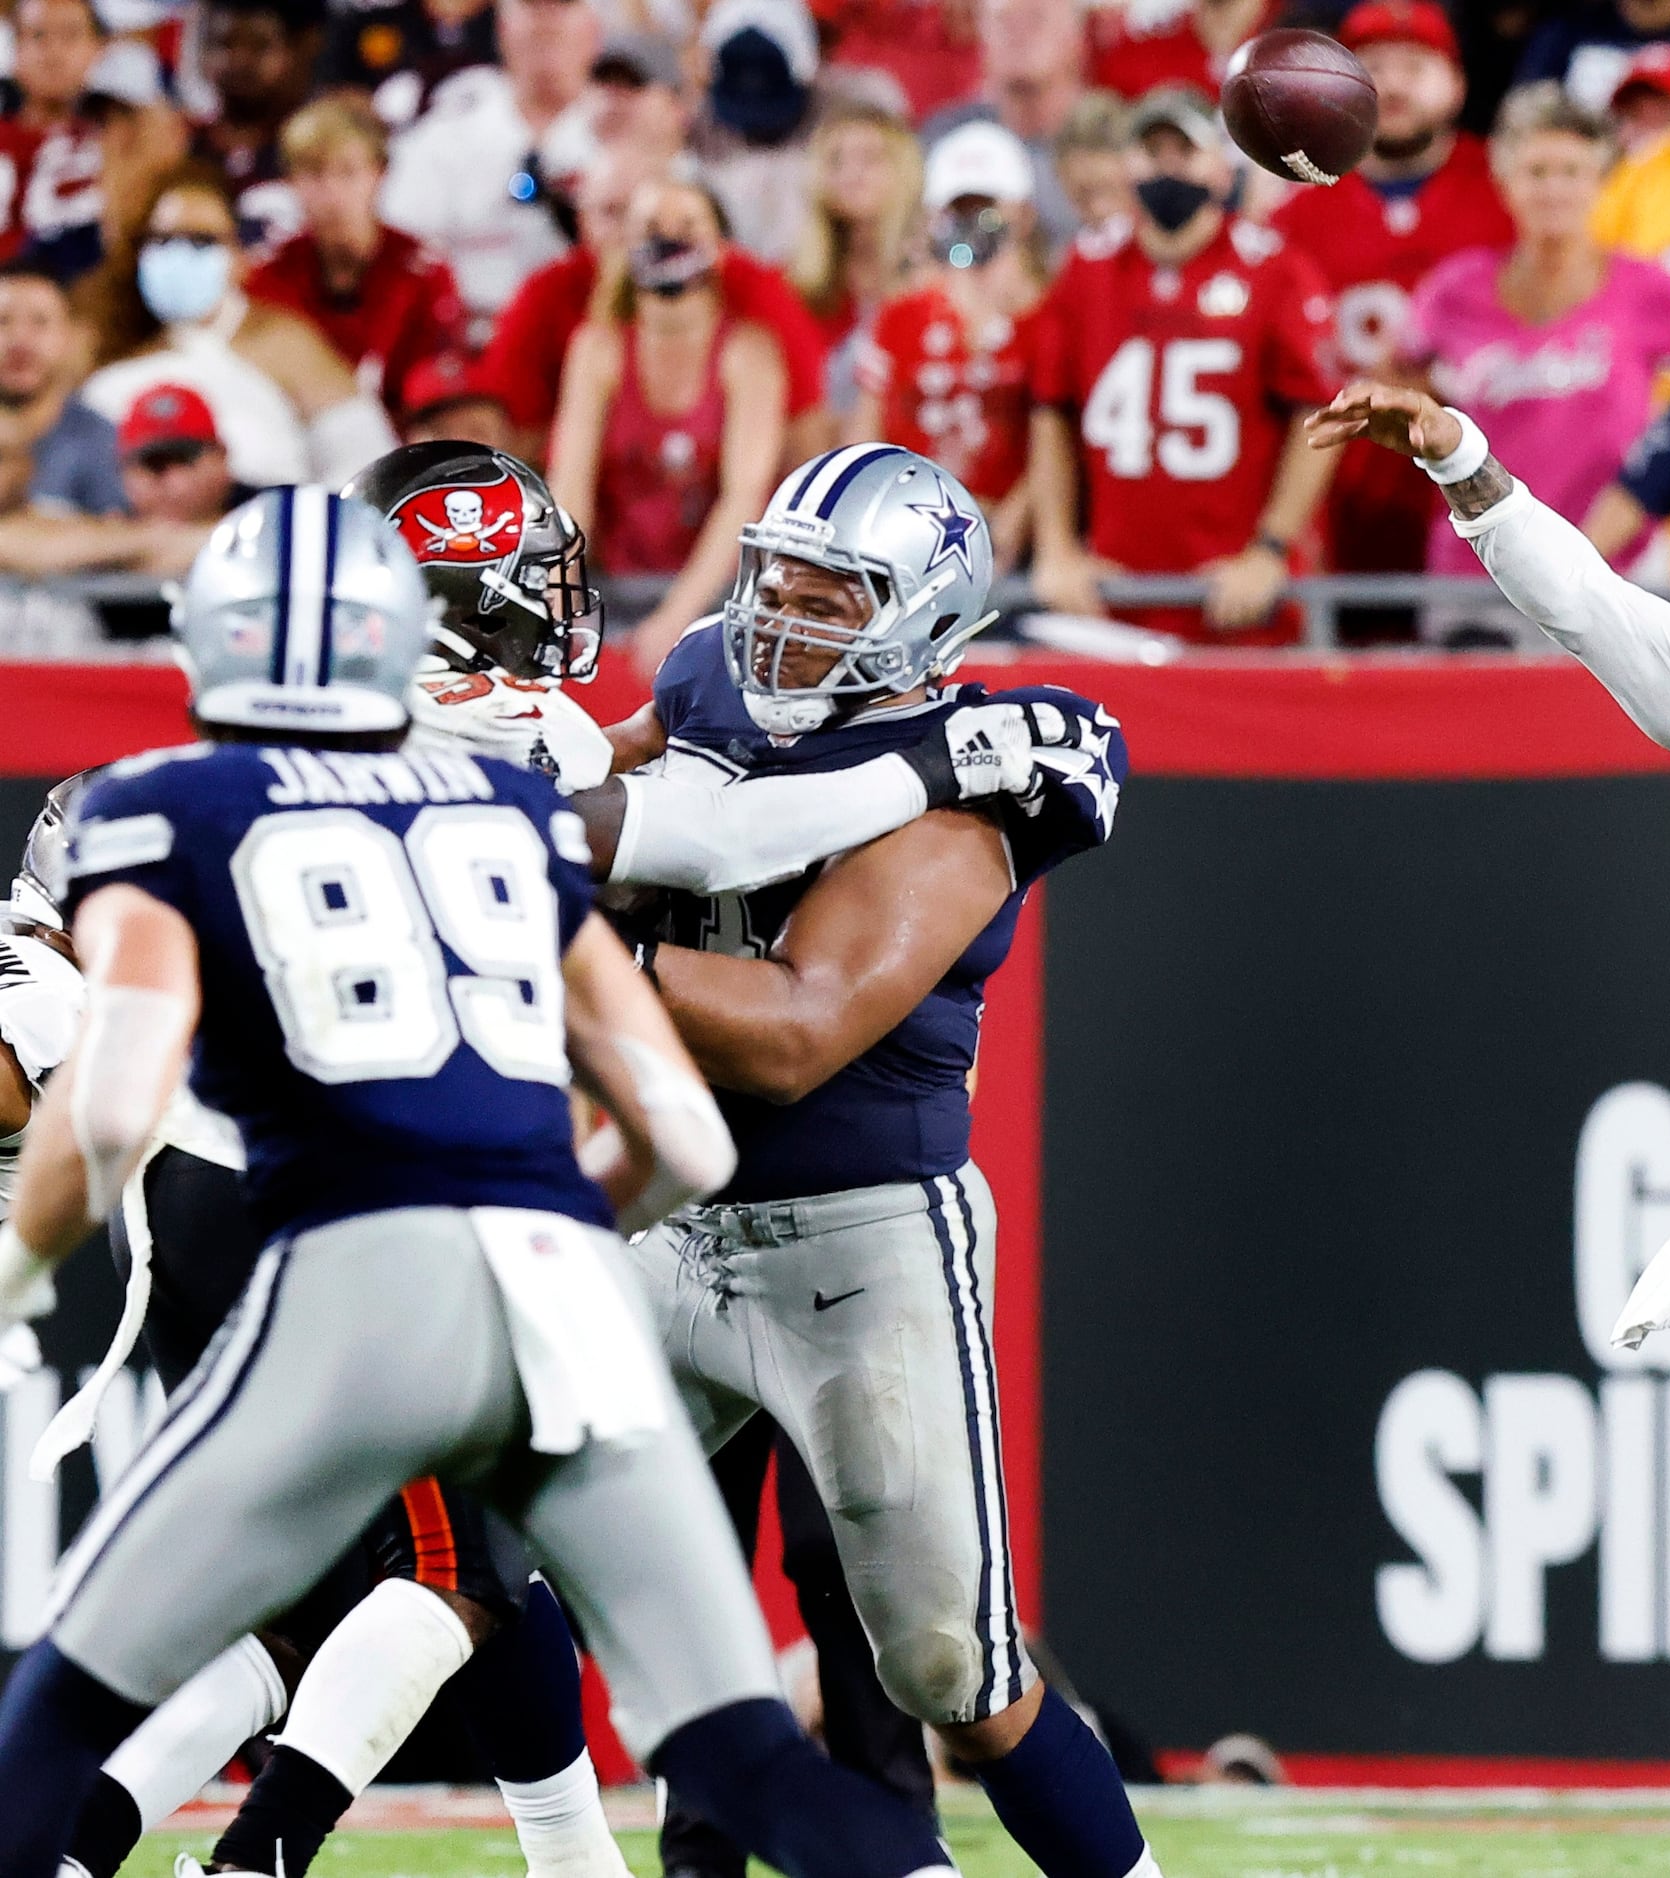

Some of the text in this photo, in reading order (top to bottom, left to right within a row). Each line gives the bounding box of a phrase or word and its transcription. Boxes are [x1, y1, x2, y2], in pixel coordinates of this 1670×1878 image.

[1083, 337, 1243, 481] 45
[951, 752, 1003, 769] adidas
[230, 804, 572, 1086] 89
